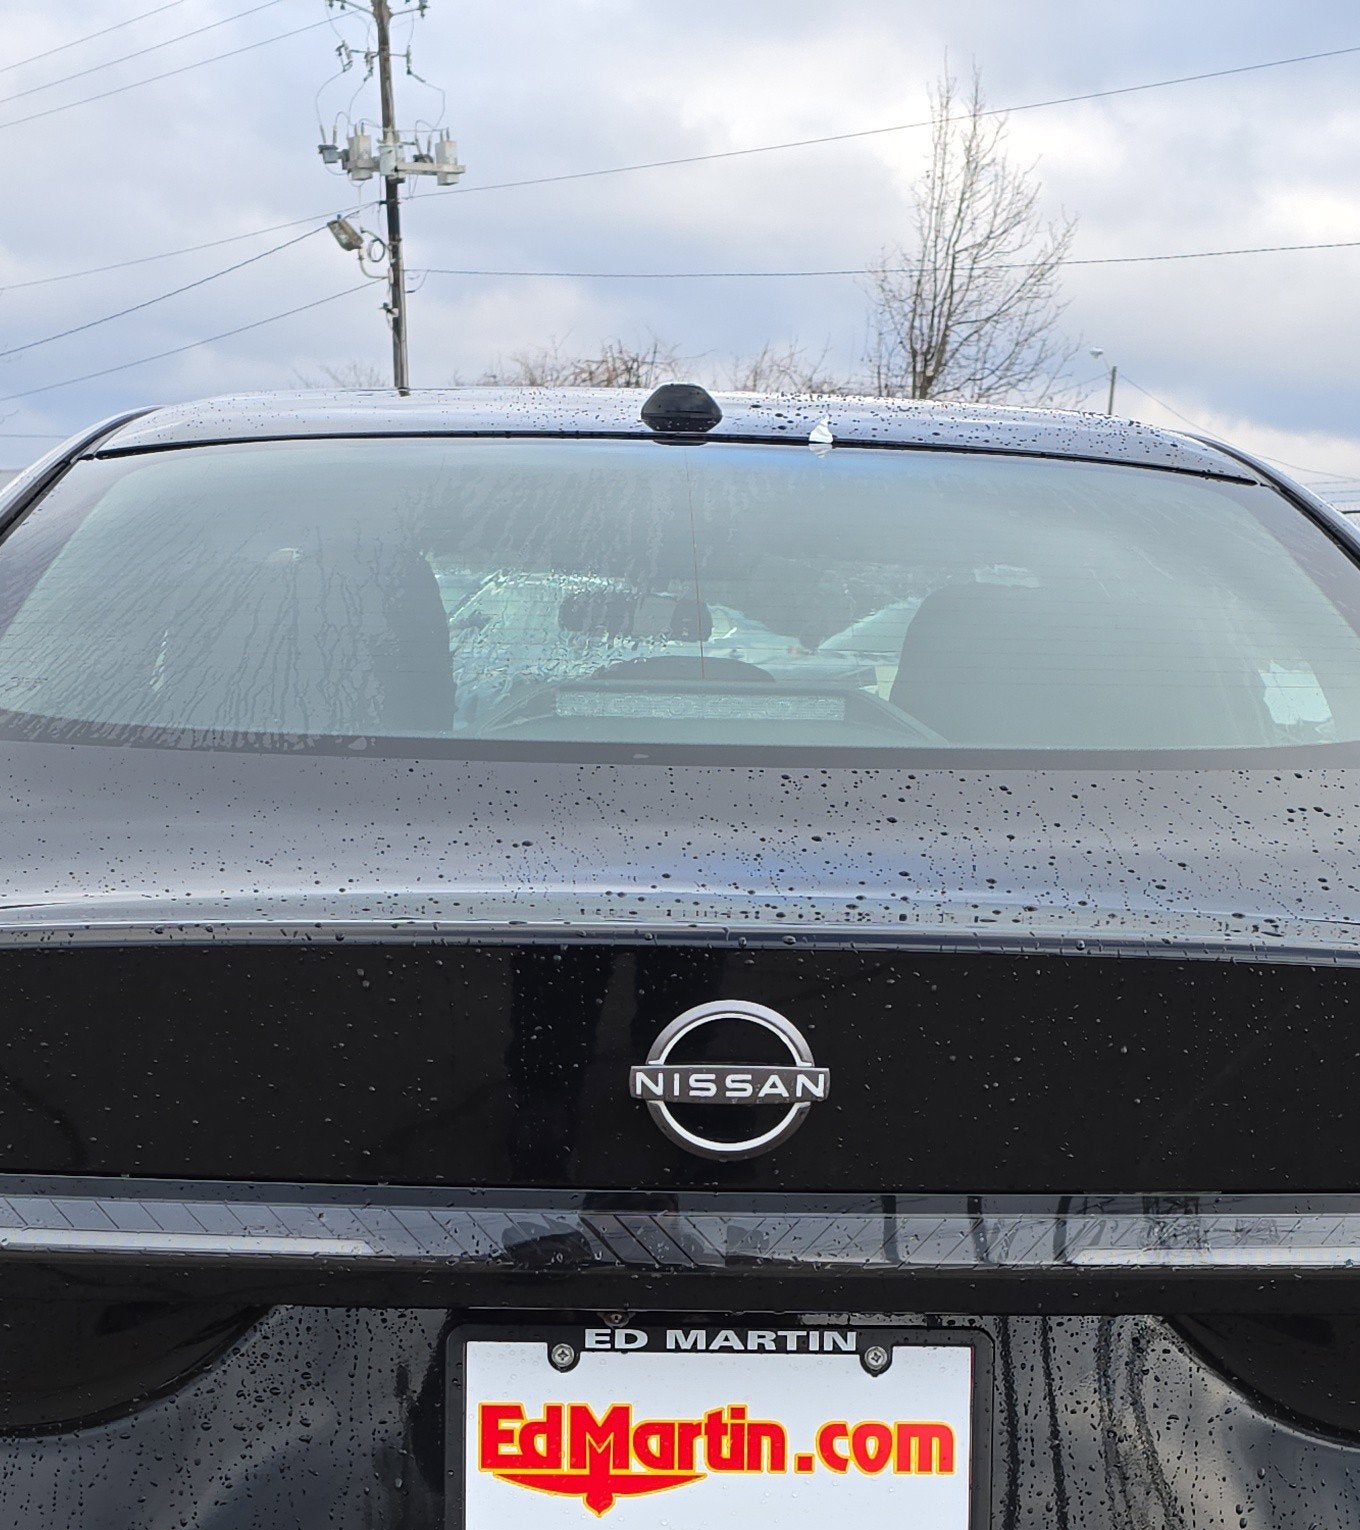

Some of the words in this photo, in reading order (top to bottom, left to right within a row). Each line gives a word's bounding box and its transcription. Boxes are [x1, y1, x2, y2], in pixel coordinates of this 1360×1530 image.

[635, 1070, 825, 1098] NISSAN
[583, 1328, 649, 1351] ED
[665, 1329, 857, 1352] MARTIN
